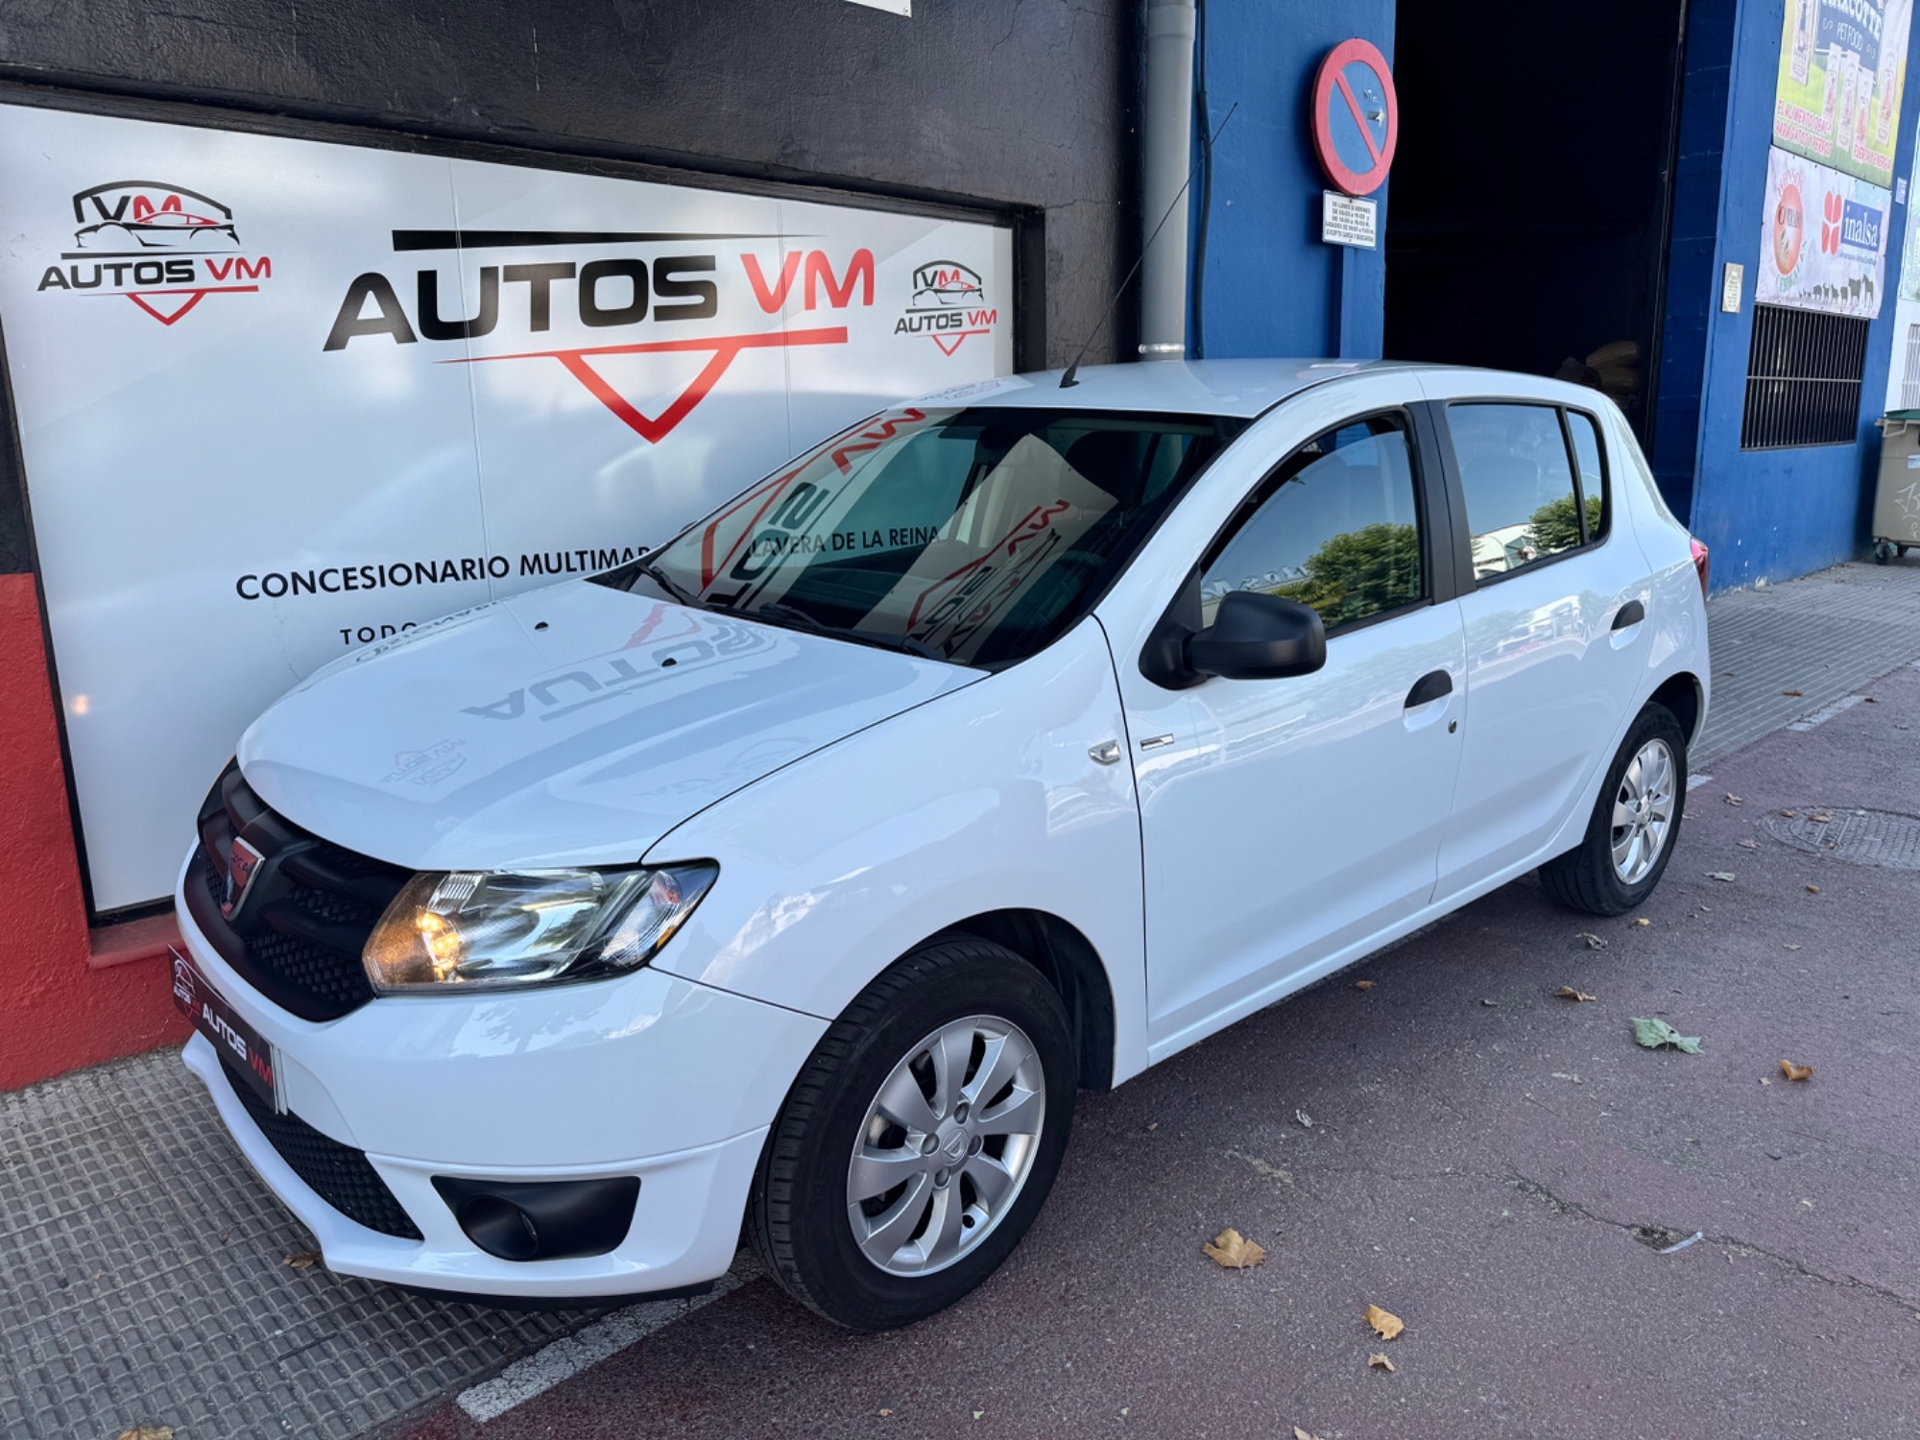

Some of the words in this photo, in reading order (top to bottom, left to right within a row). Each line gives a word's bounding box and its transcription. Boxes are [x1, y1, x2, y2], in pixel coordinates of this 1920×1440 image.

[37, 260, 196, 292] AUTOS
[204, 256, 272, 281] VM
[322, 255, 718, 352] AUTOS
[740, 248, 875, 314] VM
[894, 312, 963, 335] AUTOS
[967, 309, 997, 327] VM
[832, 532, 855, 551] DE
[862, 530, 883, 548] LA
[889, 526, 940, 546] REINA
[236, 555, 510, 601] CONCESIONARIO
[202, 1002, 247, 1061] AUTOS
[248, 1045, 273, 1088] VM
